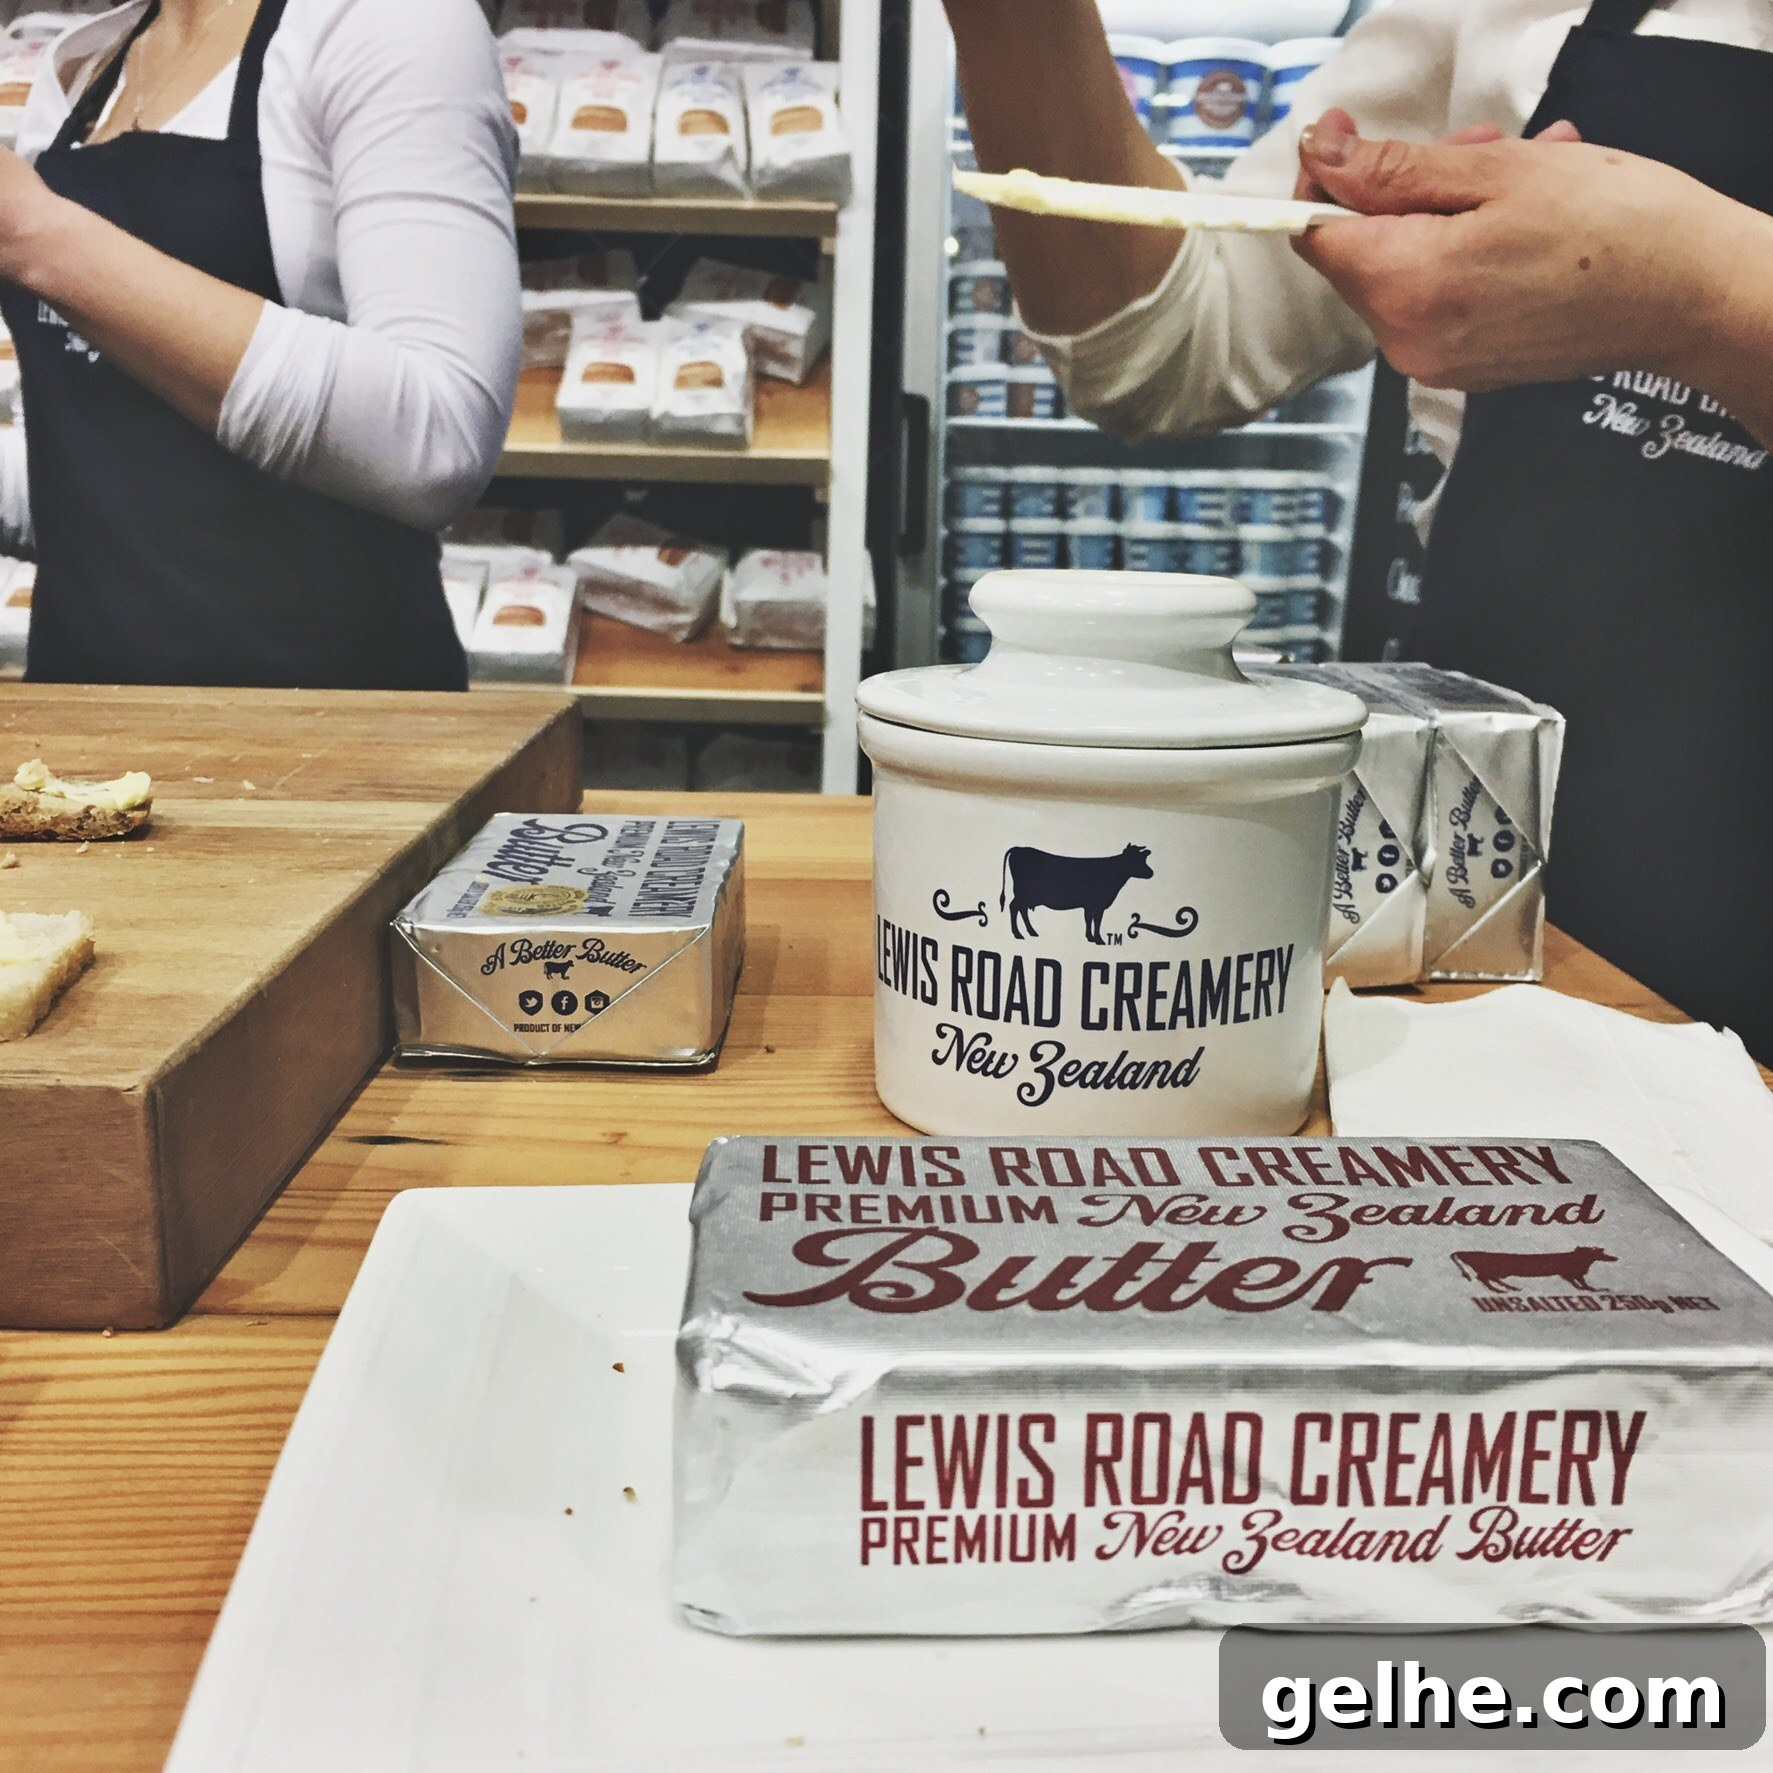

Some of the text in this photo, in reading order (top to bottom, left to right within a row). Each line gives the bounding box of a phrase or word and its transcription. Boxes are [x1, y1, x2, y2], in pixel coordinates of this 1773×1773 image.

[1582, 393, 1650, 437] New
[481, 818, 609, 885] Butter
[1446, 832, 1469, 885] Better
[1448, 887, 1476, 909] A
[480, 937, 647, 976] A Better Butter
[876, 913, 1294, 1032] LEWIS ROAD CREAMERY
[513, 1022, 550, 1034] PRODUCT
[552, 1022, 562, 1034] OF
[931, 1022, 1205, 1107] New Zealand
[762, 1145, 1572, 1188] LEWIS ROAD CREAMERY
[759, 1191, 1606, 1243] PREMIUM New Zealand
[742, 1226, 1413, 1313] Butter
[1471, 1295, 1604, 1313] UNSALTED
[1667, 1295, 1721, 1311] NET
[861, 1409, 1648, 1511] LEWIS ROAD CREAMERY
[860, 1505, 1633, 1575] PREMIUM New Zealand Butter
